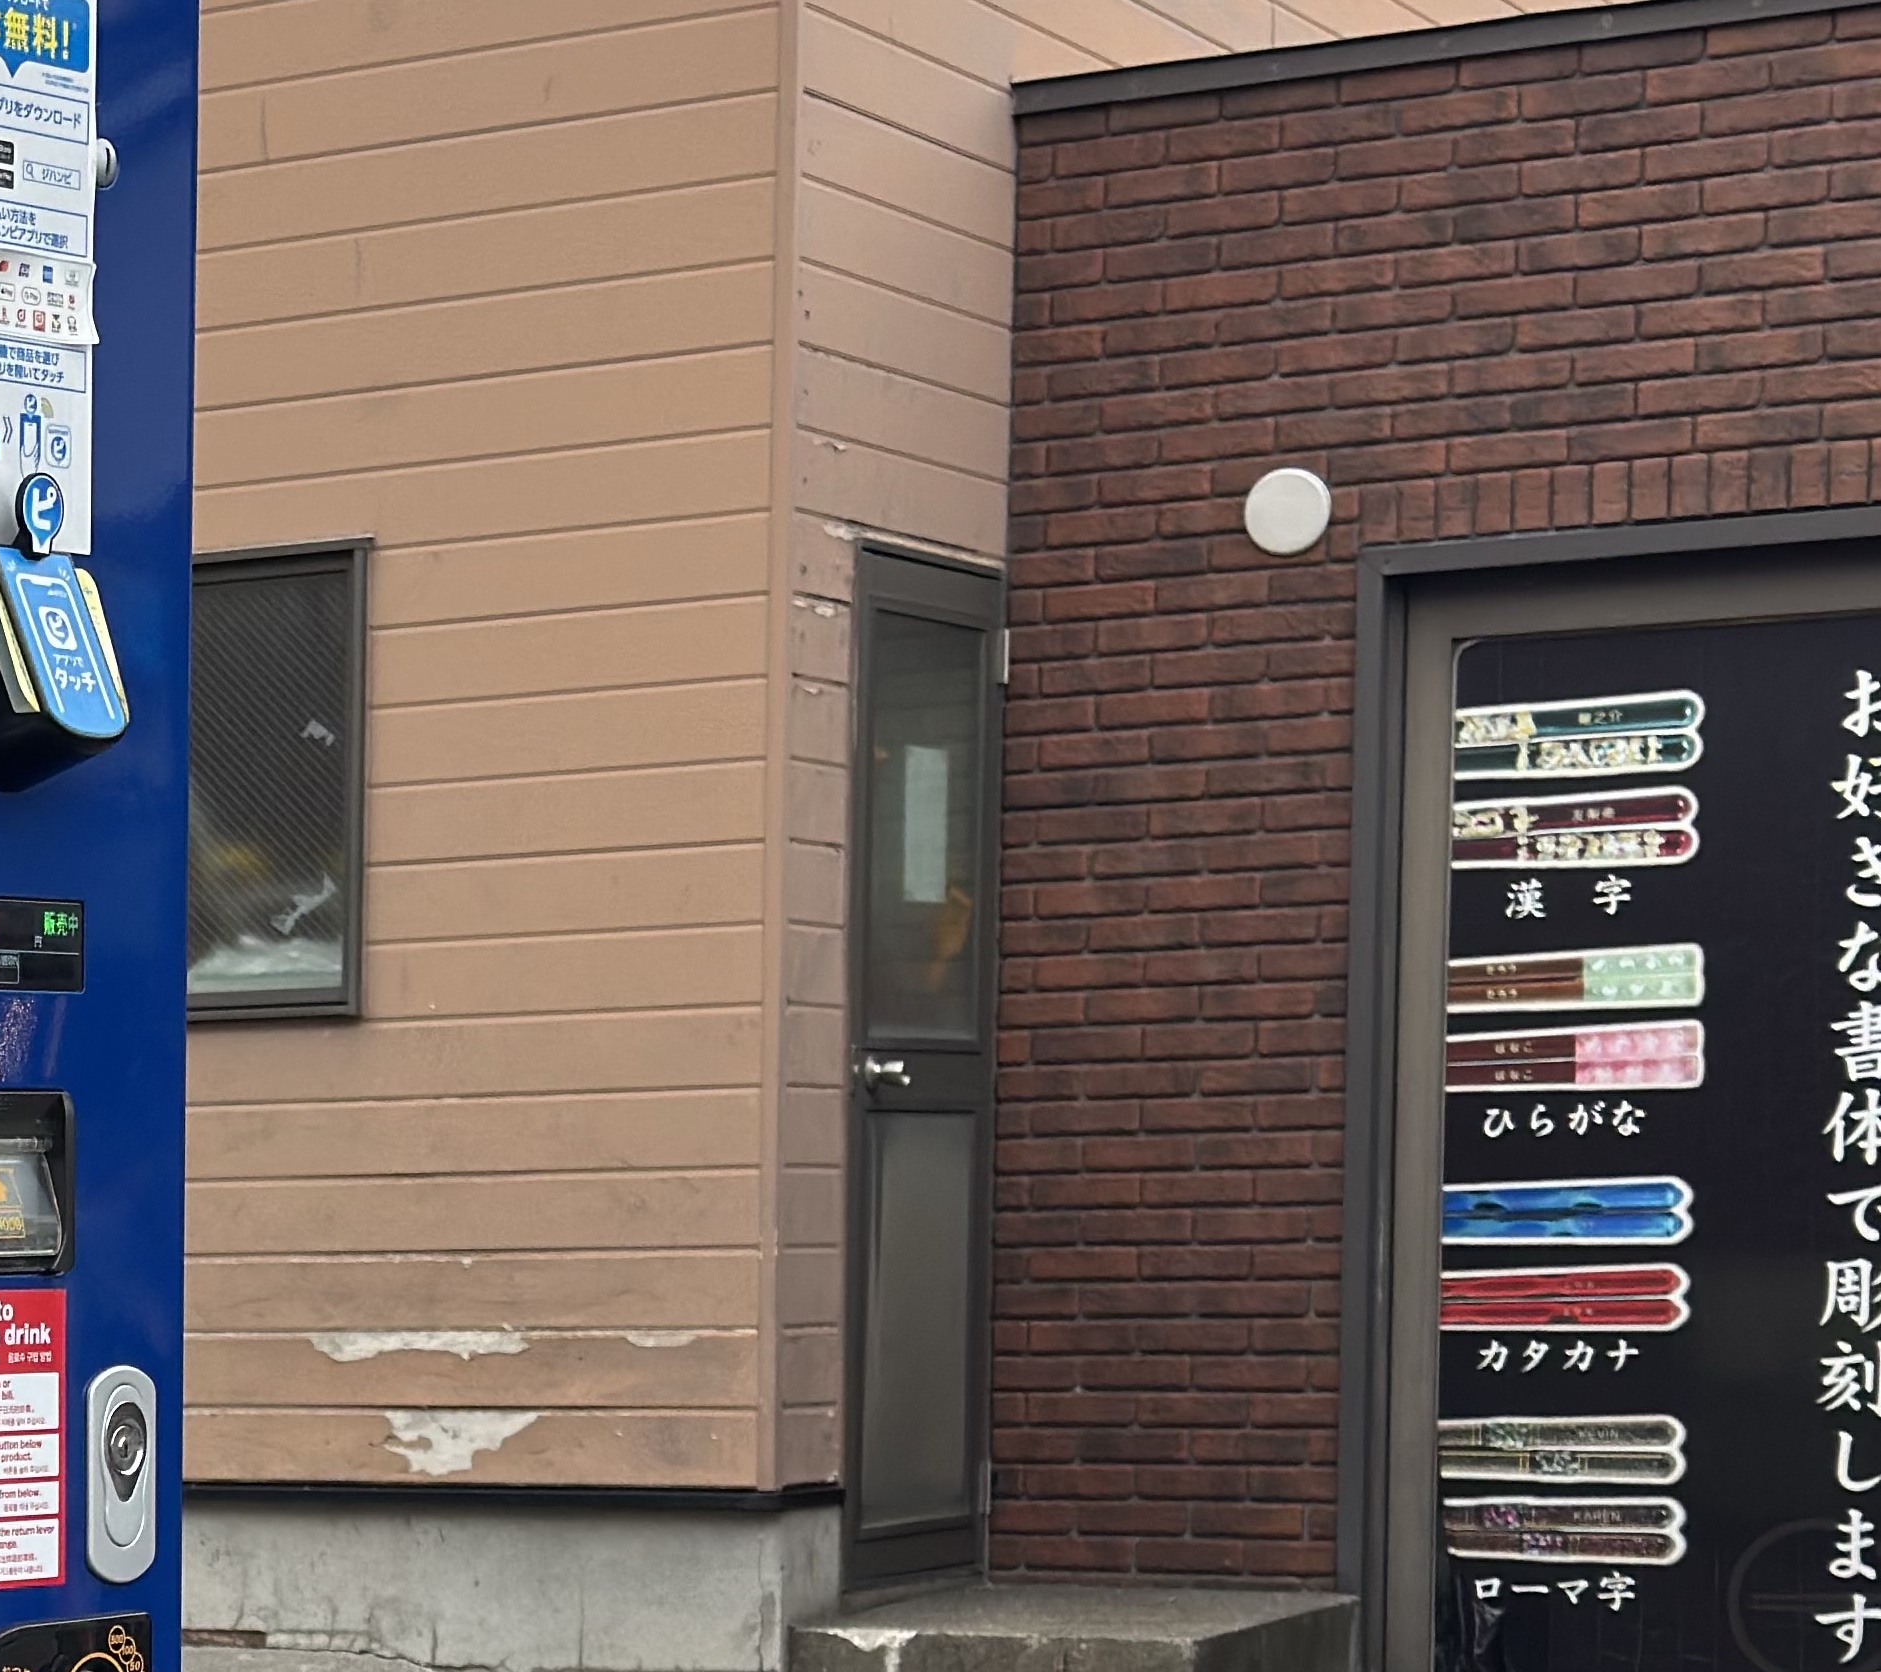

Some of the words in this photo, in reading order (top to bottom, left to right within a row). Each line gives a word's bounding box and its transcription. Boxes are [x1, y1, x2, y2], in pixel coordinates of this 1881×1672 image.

[31, 486, 57, 531] ピ
[54, 667, 97, 694] タッチ
[43, 911, 79, 937] 販売中
[1483, 1101, 1647, 1139] ひらがな
[4, 1322, 51, 1346] drink
[1477, 1339, 1641, 1374] カタカナ
[1573, 1510, 1621, 1522] KAREN
[1474, 1572, 1637, 1612] ローマ字
[130, 1662, 141, 1671] 50
